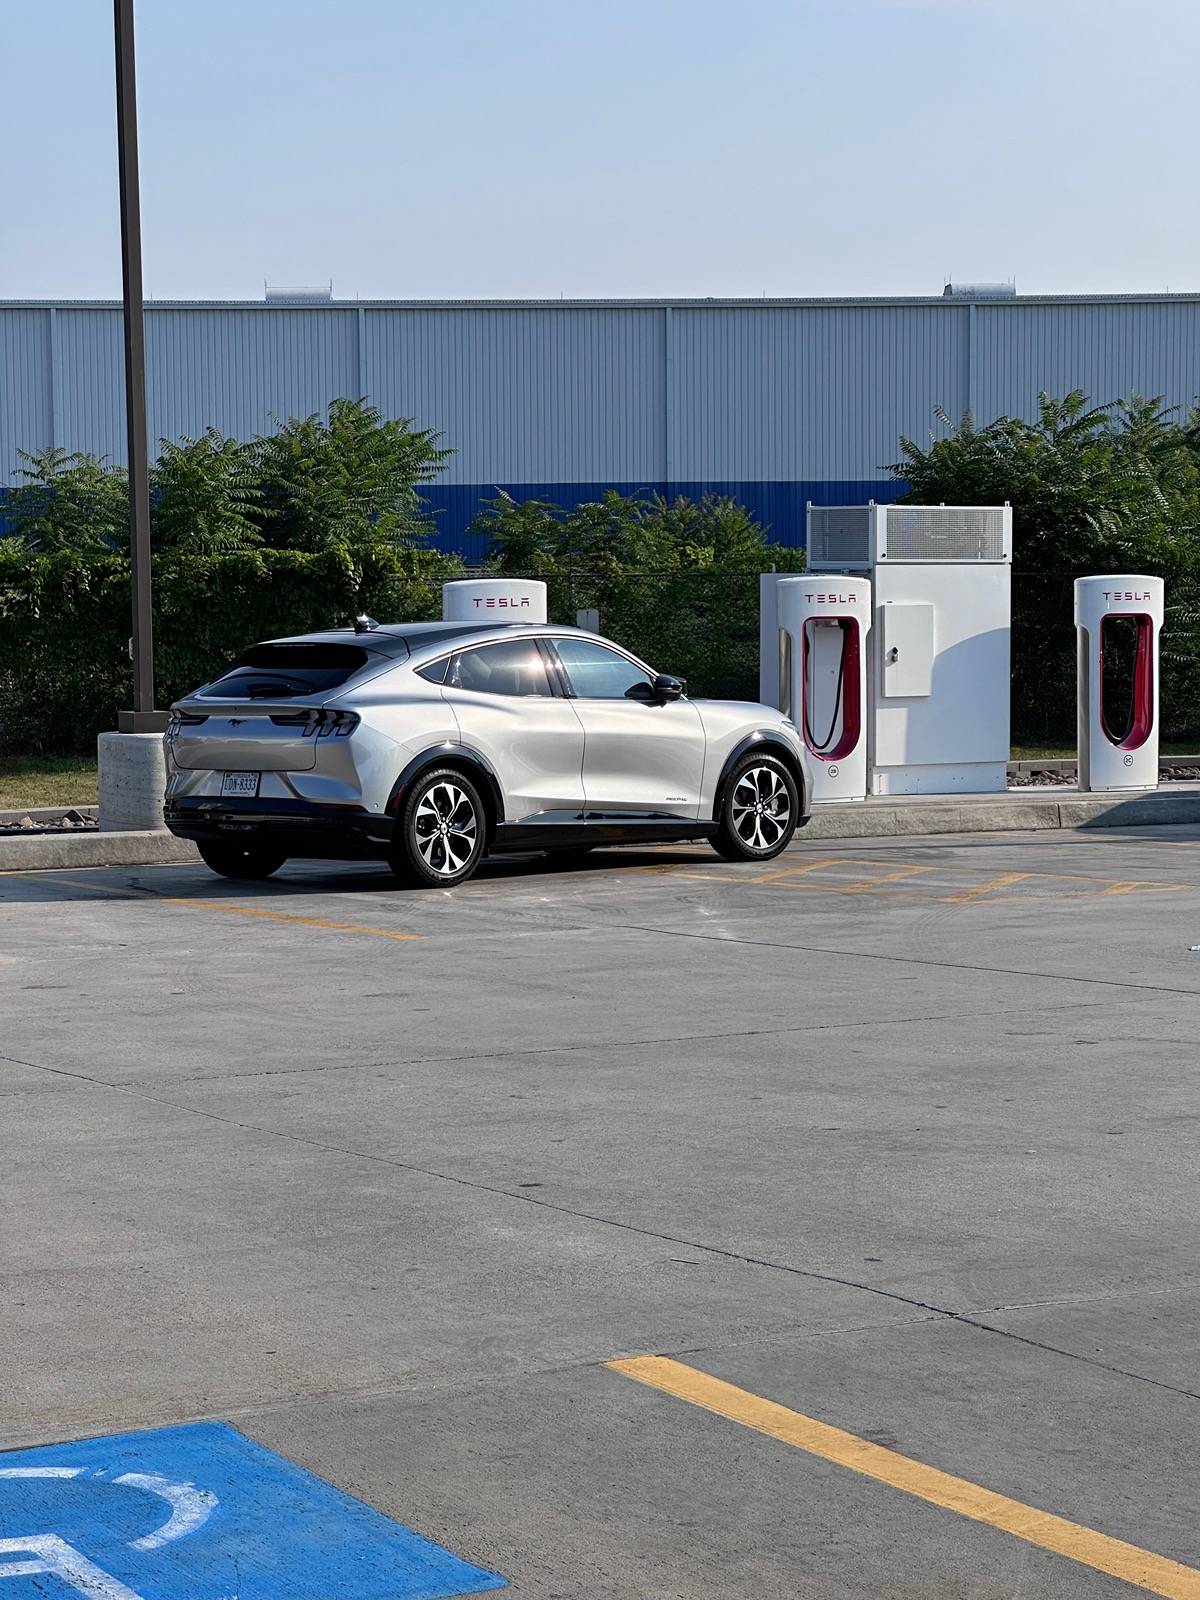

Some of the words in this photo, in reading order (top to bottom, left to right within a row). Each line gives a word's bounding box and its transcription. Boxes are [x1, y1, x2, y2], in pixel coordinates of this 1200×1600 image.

[804, 594, 856, 603] TESLA
[1102, 592, 1151, 601] TESLA
[472, 597, 530, 608] TESLA
